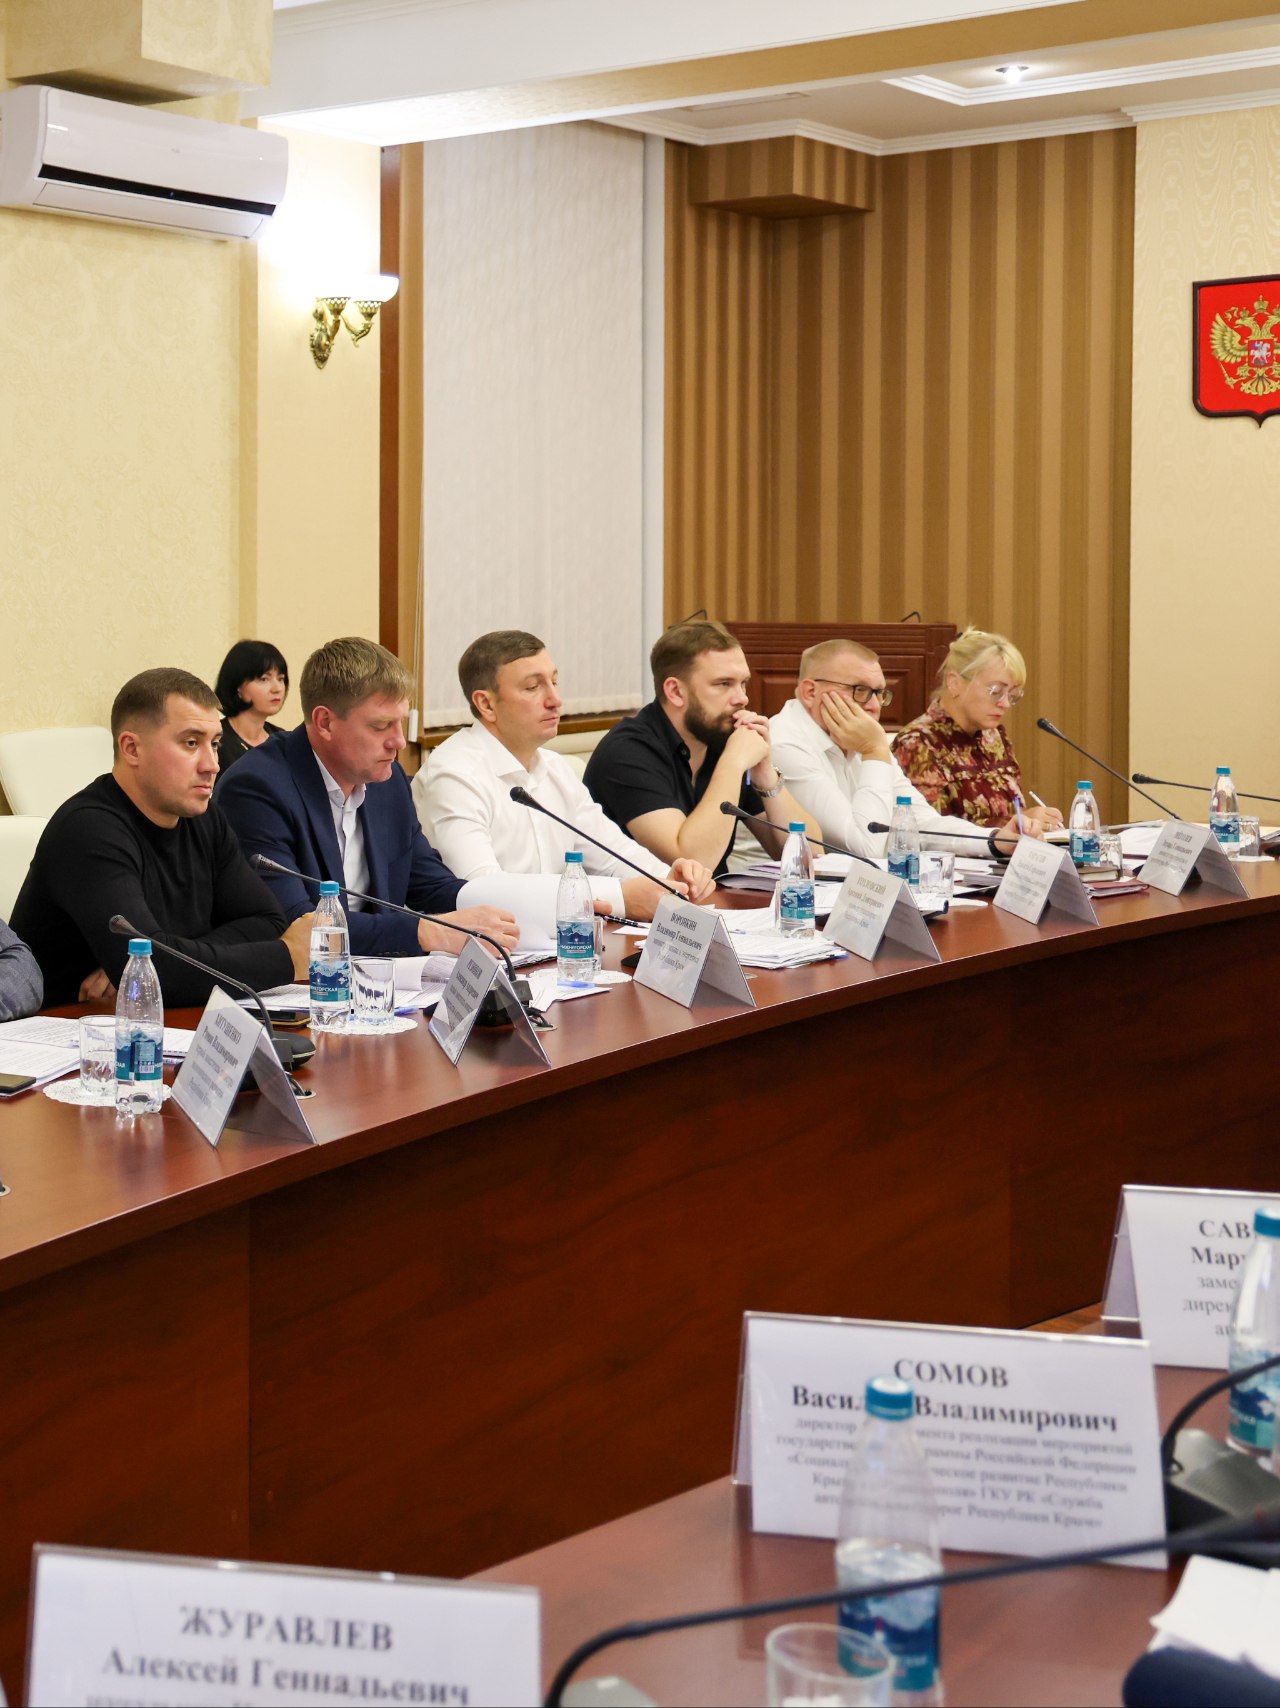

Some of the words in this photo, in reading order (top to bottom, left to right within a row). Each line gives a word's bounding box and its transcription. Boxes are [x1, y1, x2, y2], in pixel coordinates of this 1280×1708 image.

[1199, 1219, 1252, 1239] САВ
[893, 1358, 1008, 1388] СОМОВ
[915, 1395, 1118, 1432] Владимирович
[180, 1605, 392, 1651] ЖУРАВЛЕВ
[102, 1646, 239, 1685] Алексей
[251, 1658, 469, 1706] Геннадьевич
